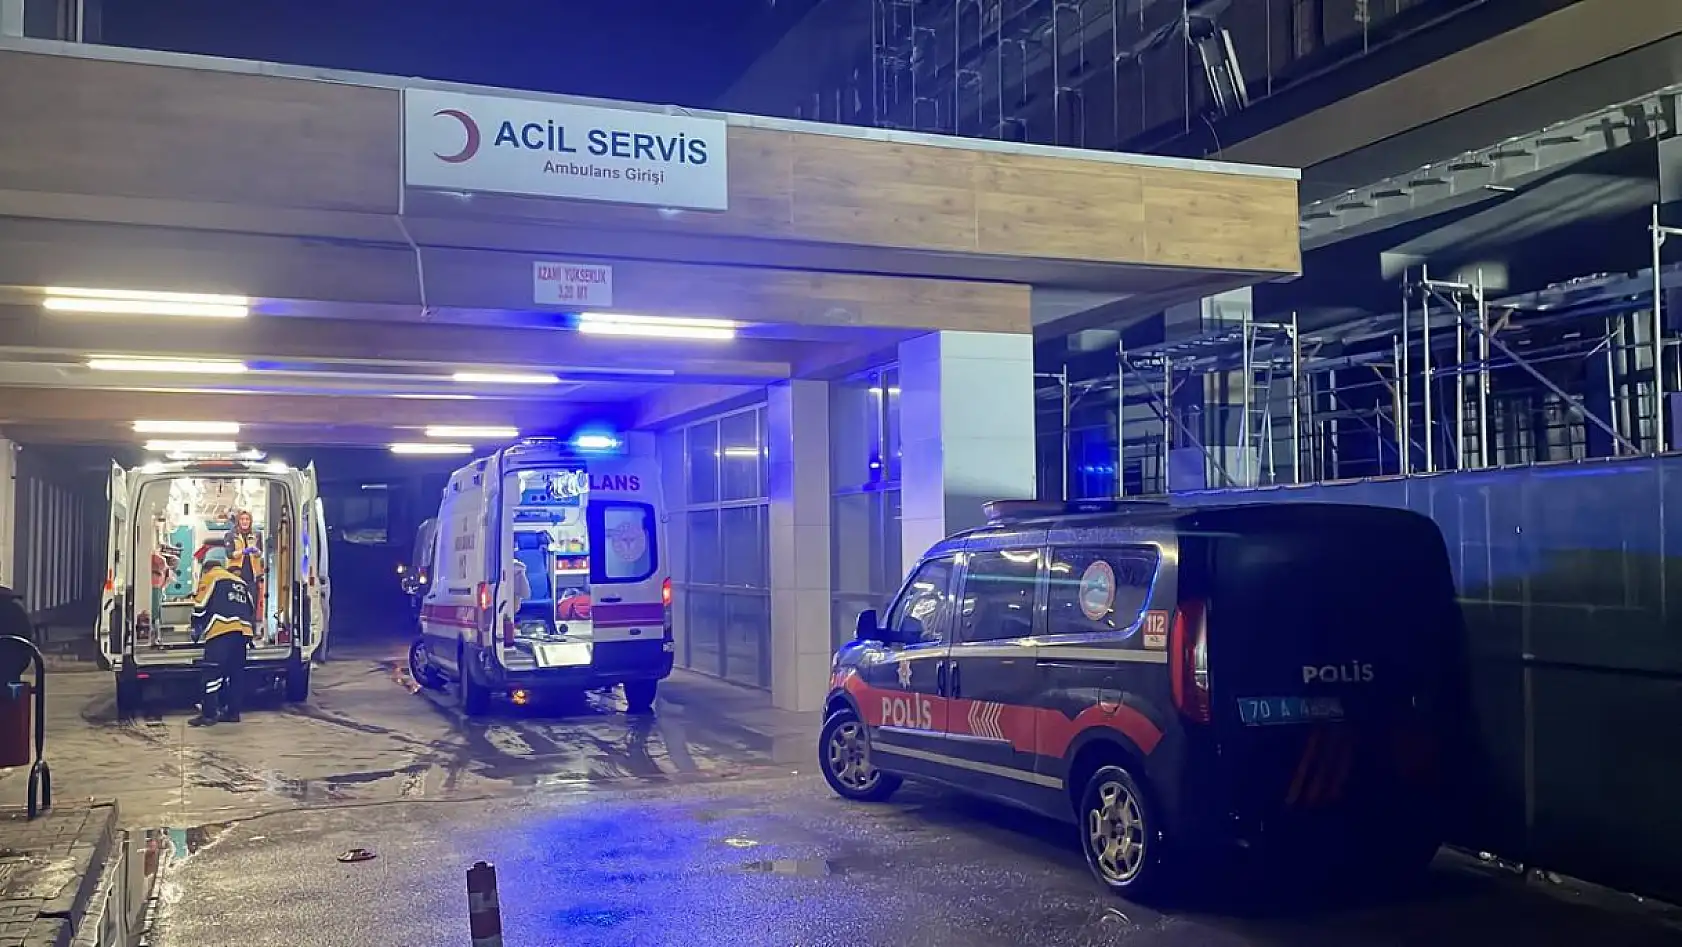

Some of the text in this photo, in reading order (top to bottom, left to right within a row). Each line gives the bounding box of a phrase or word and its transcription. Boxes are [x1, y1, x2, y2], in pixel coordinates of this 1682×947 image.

[494, 119, 708, 165] ACİL SERVİS
[543, 159, 665, 187] Ambulans Girişi
[1147, 613, 1165, 633] 112
[1302, 660, 1375, 684] POLİS
[881, 692, 933, 730] POLİS
[1250, 699, 1270, 718] 70
